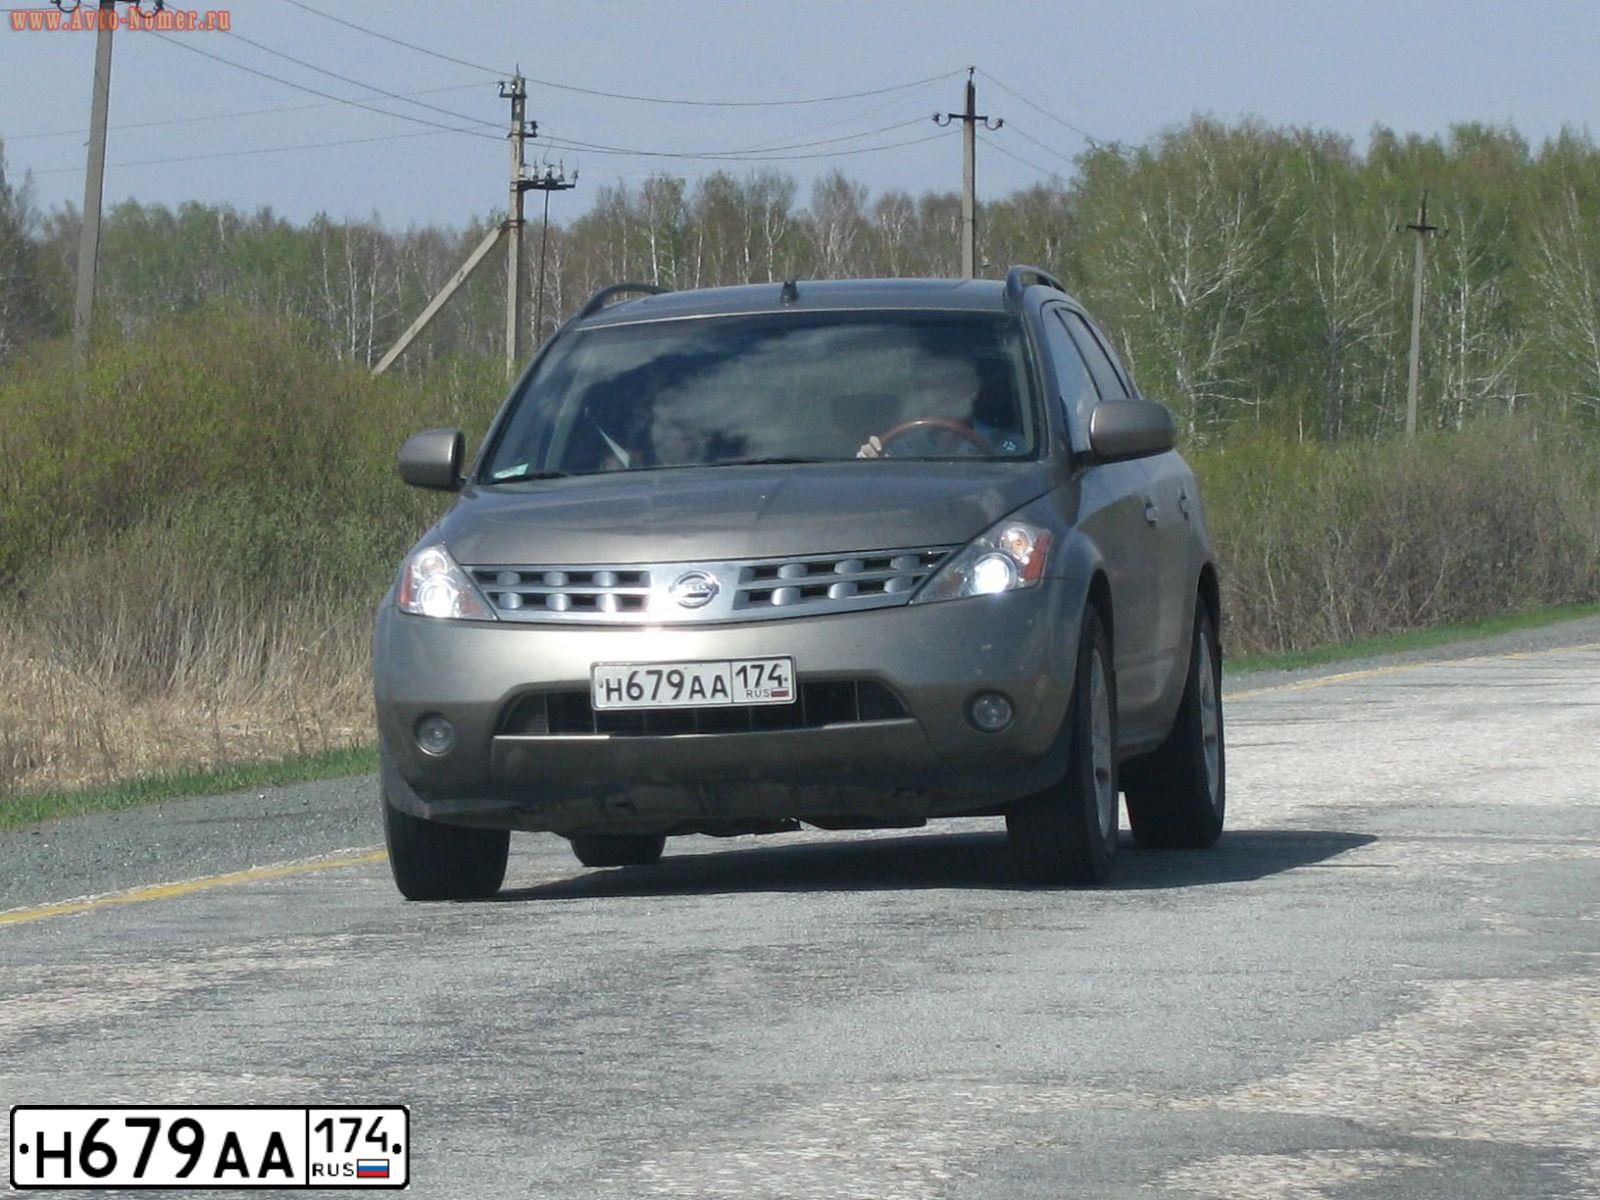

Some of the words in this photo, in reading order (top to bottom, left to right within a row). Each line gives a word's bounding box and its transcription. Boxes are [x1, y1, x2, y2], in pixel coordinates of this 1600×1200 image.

[605, 669, 728, 701] H679AA
[735, 663, 783, 689] 174
[746, 689, 770, 698] RUS
